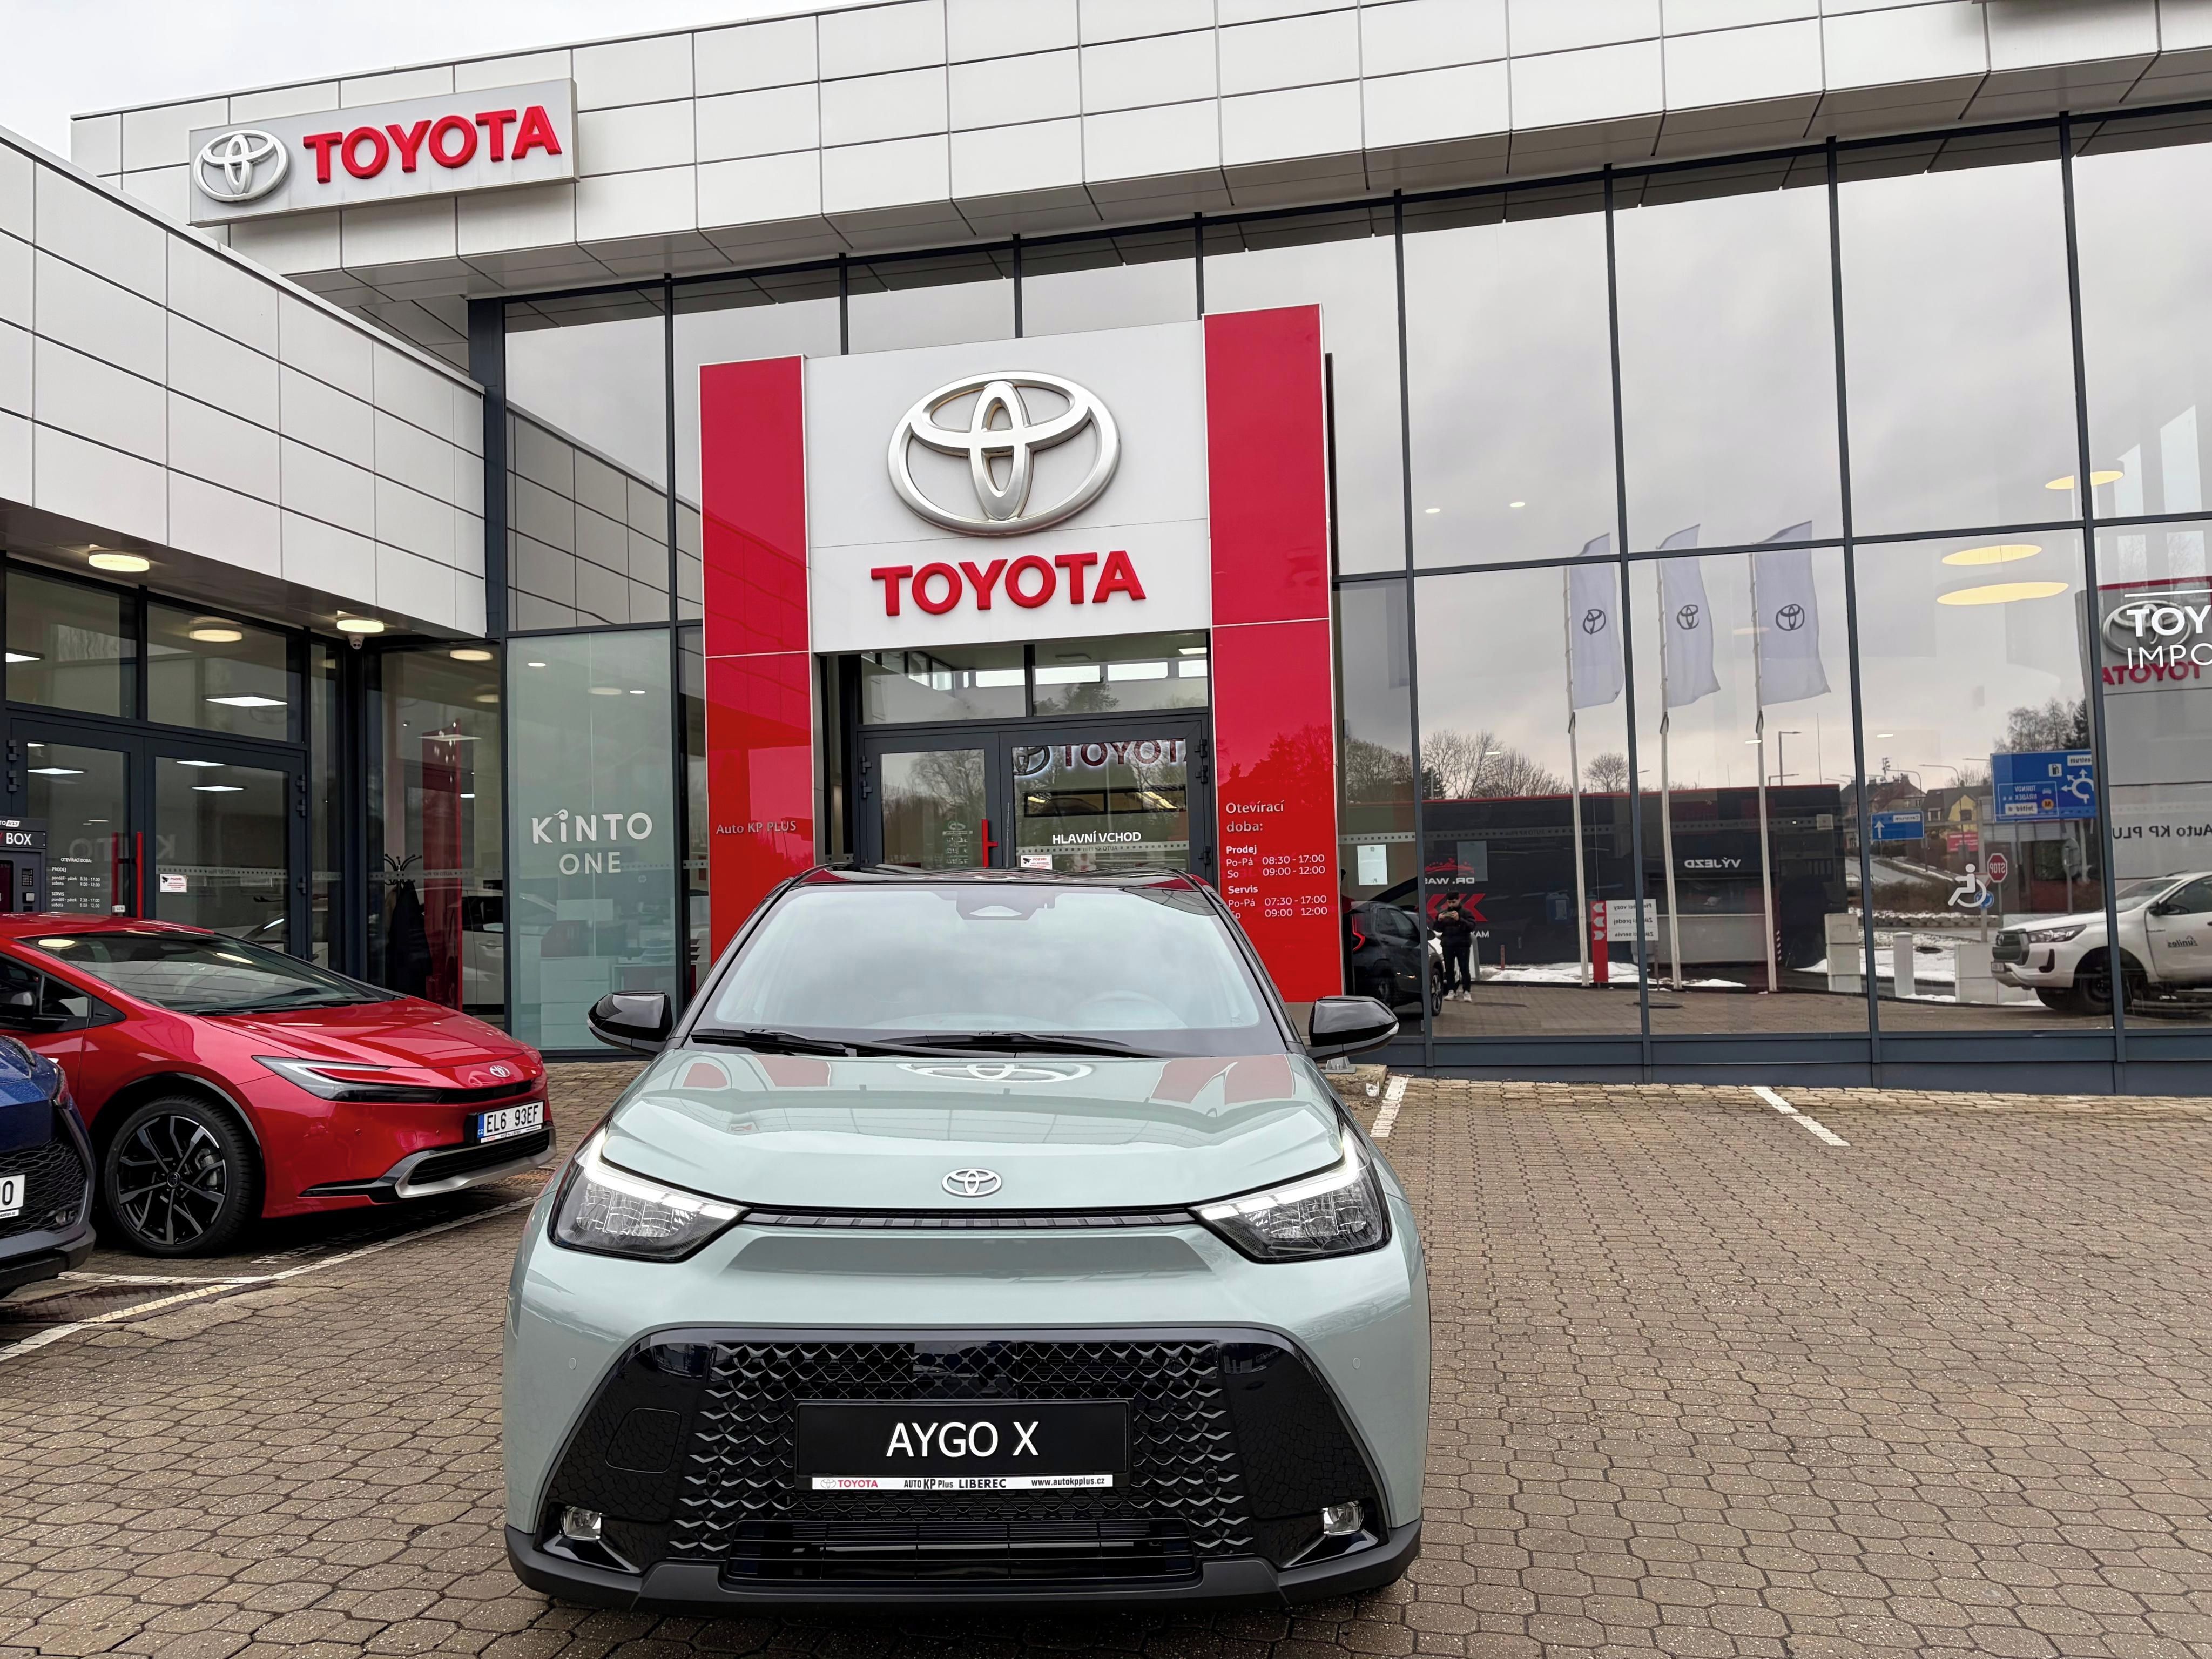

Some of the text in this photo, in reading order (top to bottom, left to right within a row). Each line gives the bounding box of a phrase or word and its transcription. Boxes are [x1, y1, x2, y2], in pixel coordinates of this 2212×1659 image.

[304, 105, 561, 183] TOYOTA
[871, 550, 1146, 616] TOYOTA
[2126, 605, 2212, 637] TOY
[2128, 643, 2212, 669] IMPO
[1057, 738, 1186, 767] TOYOT
[1226, 800, 1284, 813] Otevírací
[716, 820, 796, 834] Auto KP PLUS
[1226, 821, 1263, 832] doba:
[6, 832, 32, 845] BOX
[1053, 830, 1141, 844] HLAVNÍ VCHOD
[1226, 845, 1257, 855] Prodej
[559, 852, 621, 875] ONE
[1226, 858, 1253, 866] Po-Pá
[1262, 856, 1290, 865] 08:30
[1298, 854, 1325, 863] 17:00
[1227, 870, 1239, 878] So
[1263, 867, 1291, 876] 09:00
[1299, 866, 1325, 874] 12:00
[1228, 885, 1258, 894] Servis
[1228, 899, 1255, 907] Po-Pá
[1264, 897, 1292, 906] 07:30
[1300, 895, 1326, 904] 17:00
[1265, 908, 1293, 917] 09:00
[1301, 907, 1327, 916] 12:00
[487, 1105, 539, 1133] EL6 93EF
[886, 1421, 1039, 1457] AYGO X
[838, 1477, 1105, 1489] TOYOTA AUTO KP Plus LIBEREC www.autokpplus.cz
